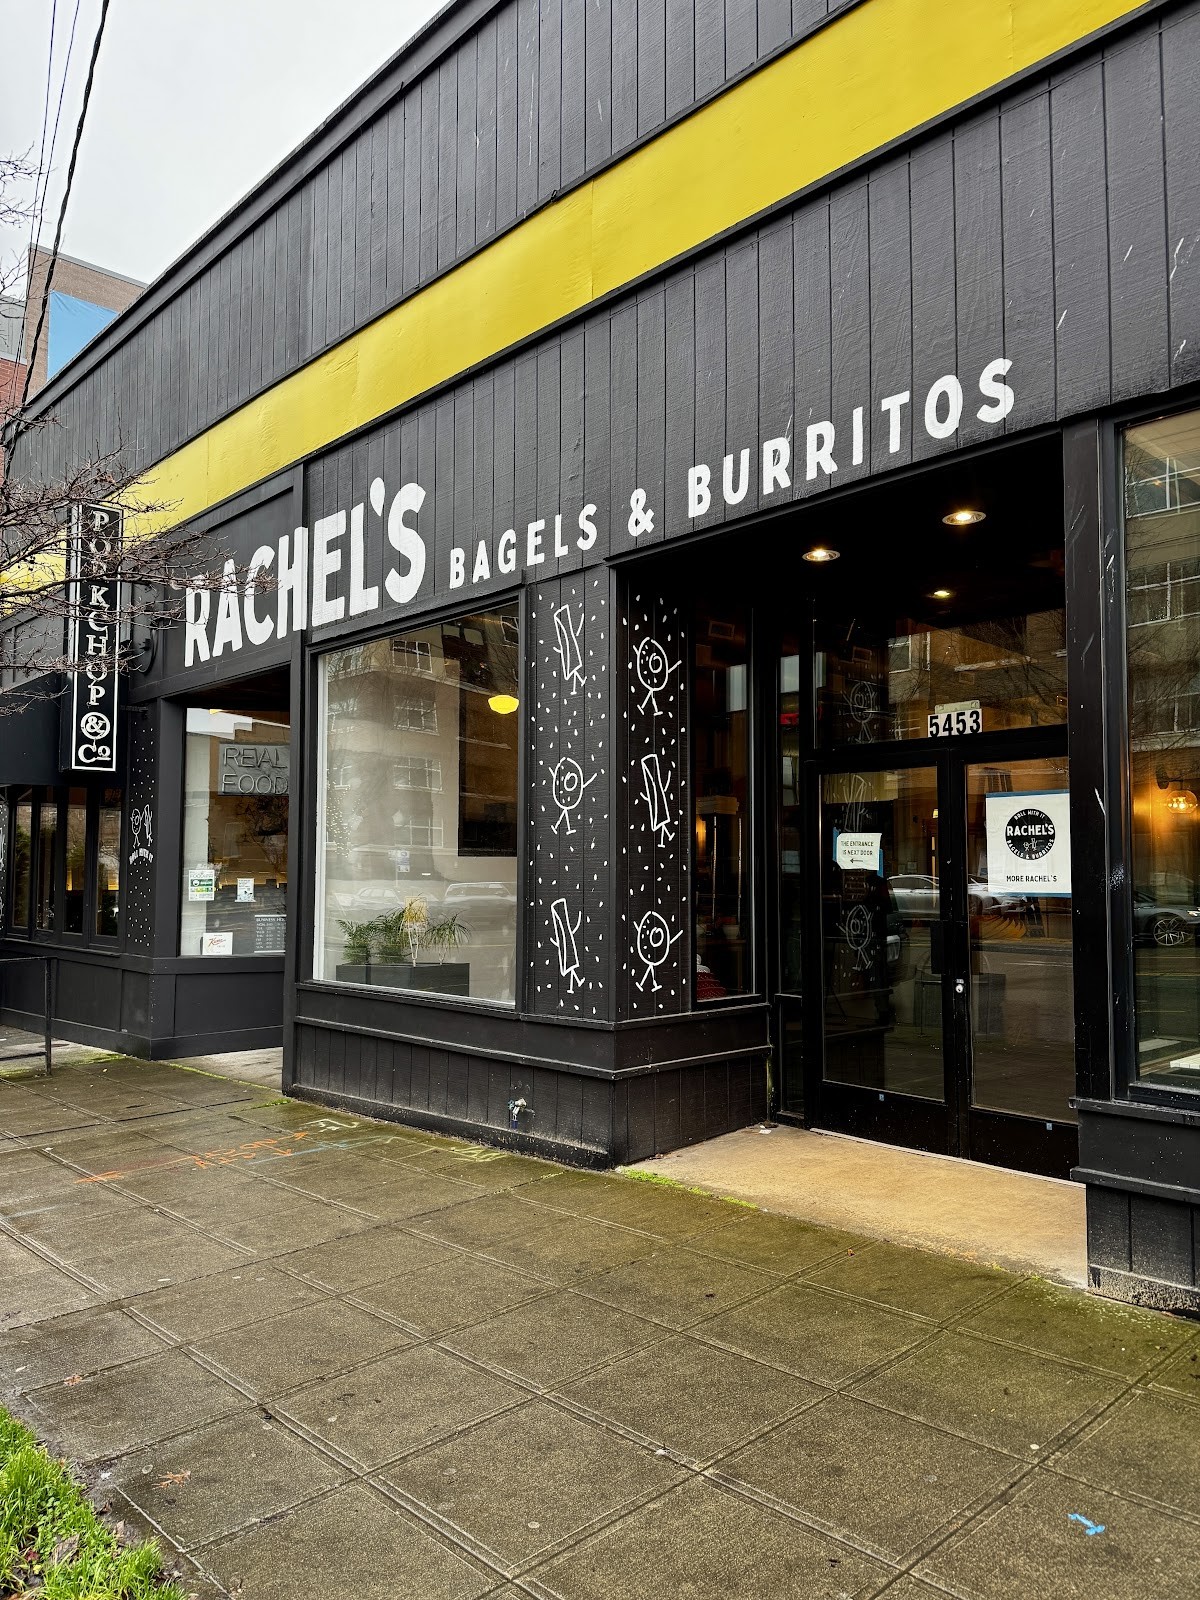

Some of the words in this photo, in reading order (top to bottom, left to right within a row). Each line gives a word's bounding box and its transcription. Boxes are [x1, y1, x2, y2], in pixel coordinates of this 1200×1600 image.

[185, 477, 427, 668] RACHEL'S
[449, 503, 598, 590] BAGELS
[627, 487, 655, 537] &
[687, 357, 1015, 518] BURRITOS
[84, 714, 107, 737] &
[929, 711, 981, 737] 5453
[224, 747, 288, 769] REAL
[222, 774, 288, 795] FOOD
[1006, 823, 1055, 837] RACHEL'S
[1006, 840, 1024, 858] BAGELS
